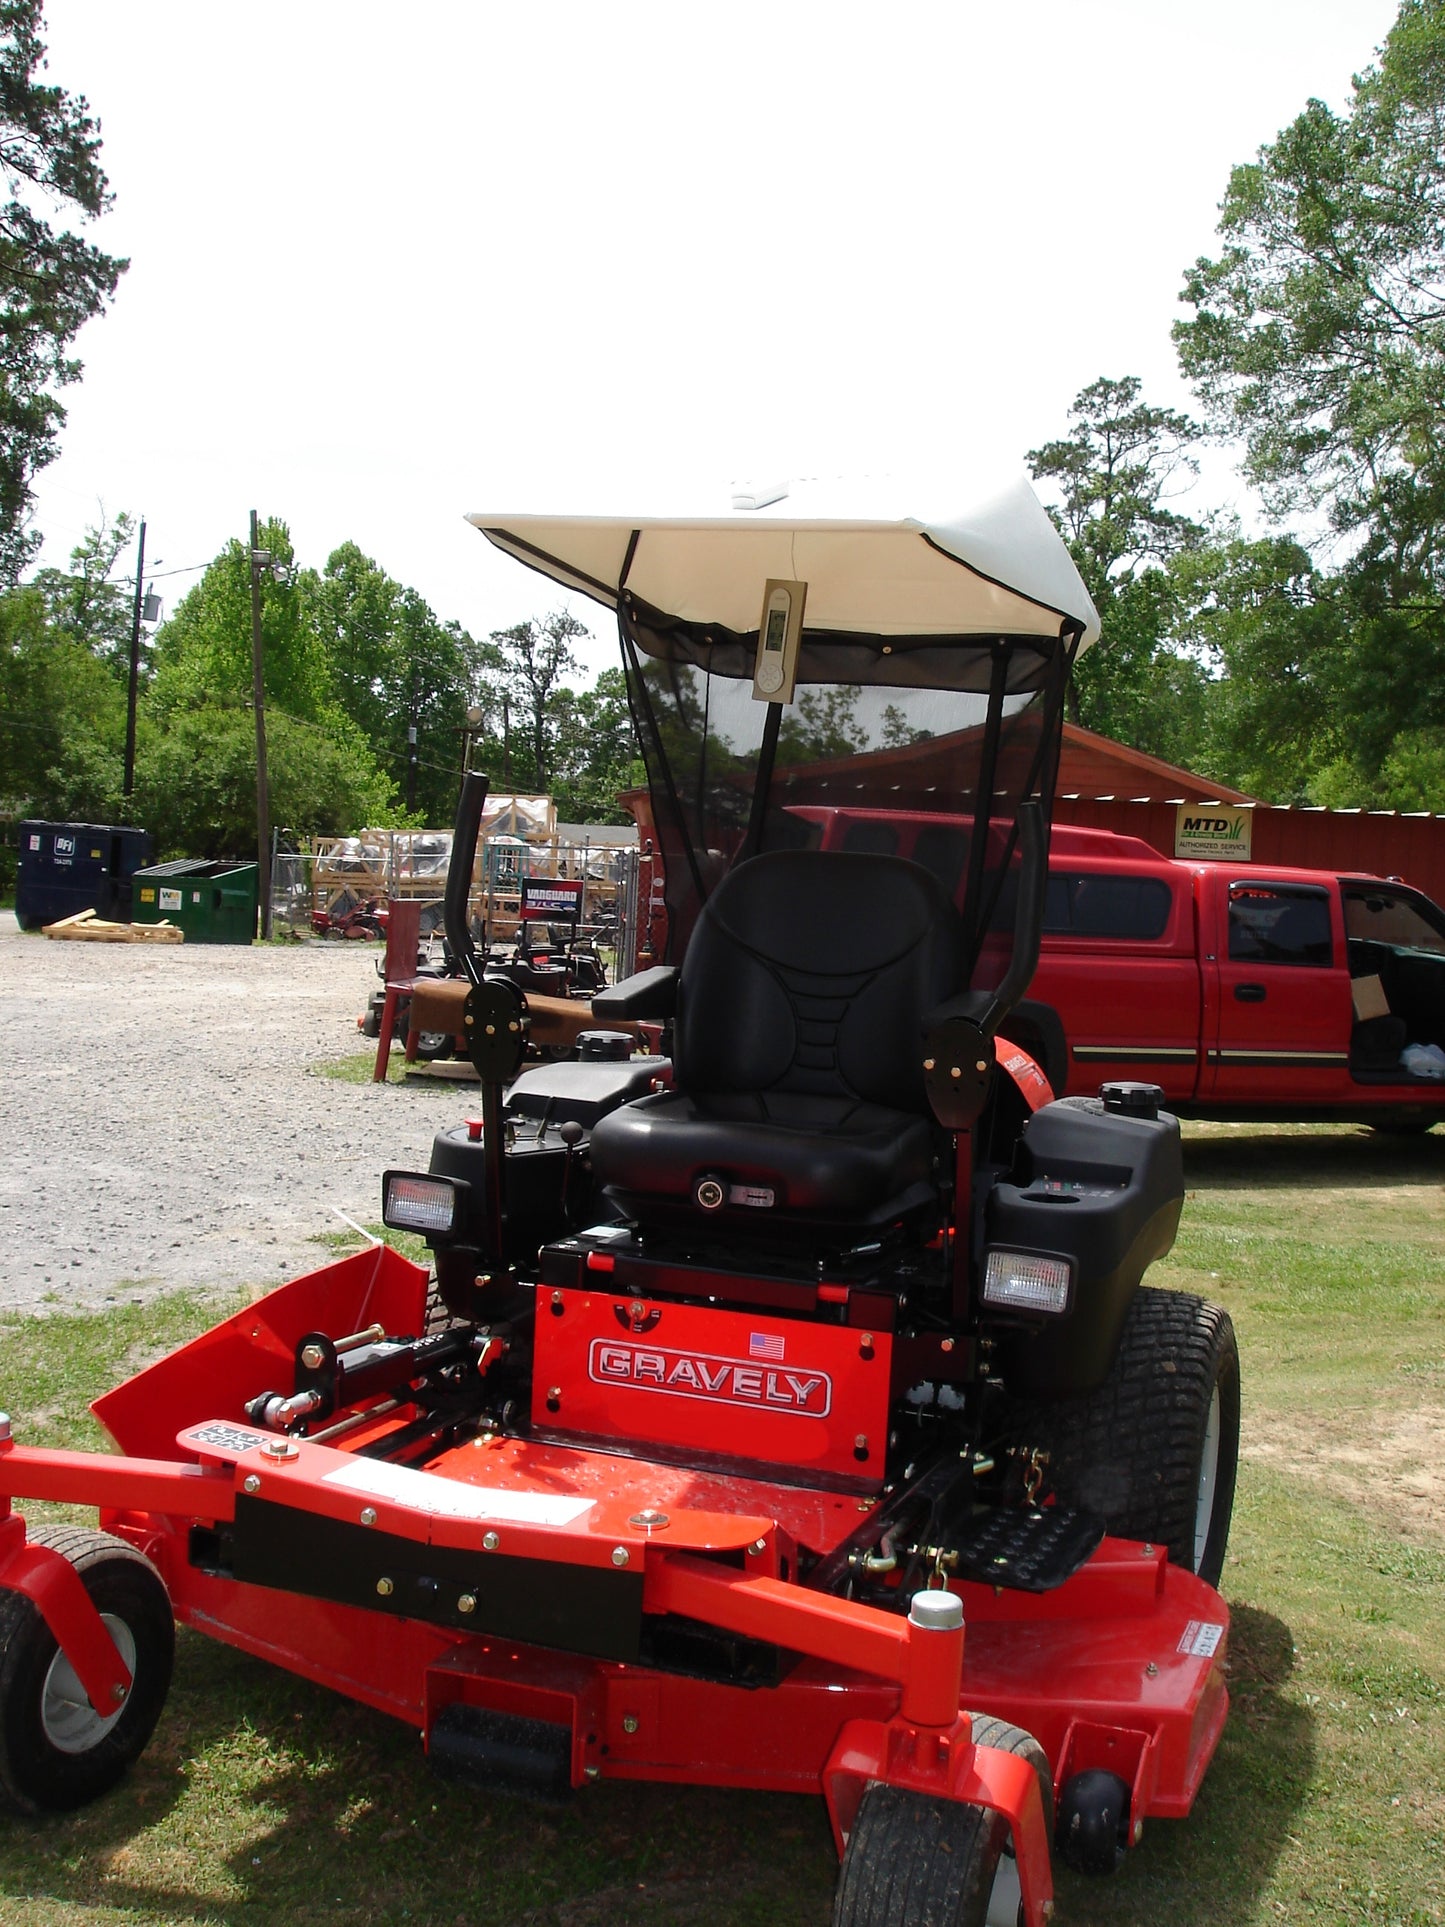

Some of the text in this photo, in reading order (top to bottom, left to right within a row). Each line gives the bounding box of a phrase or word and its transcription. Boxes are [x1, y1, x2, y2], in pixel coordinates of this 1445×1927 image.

[1183, 817, 1228, 831] MTD
[57, 838, 73, 852] BFI
[1179, 841, 1219, 849] AUTHORIZED
[527, 888, 578, 902] VANGUARD
[599, 1347, 822, 1405] GRAVELY
